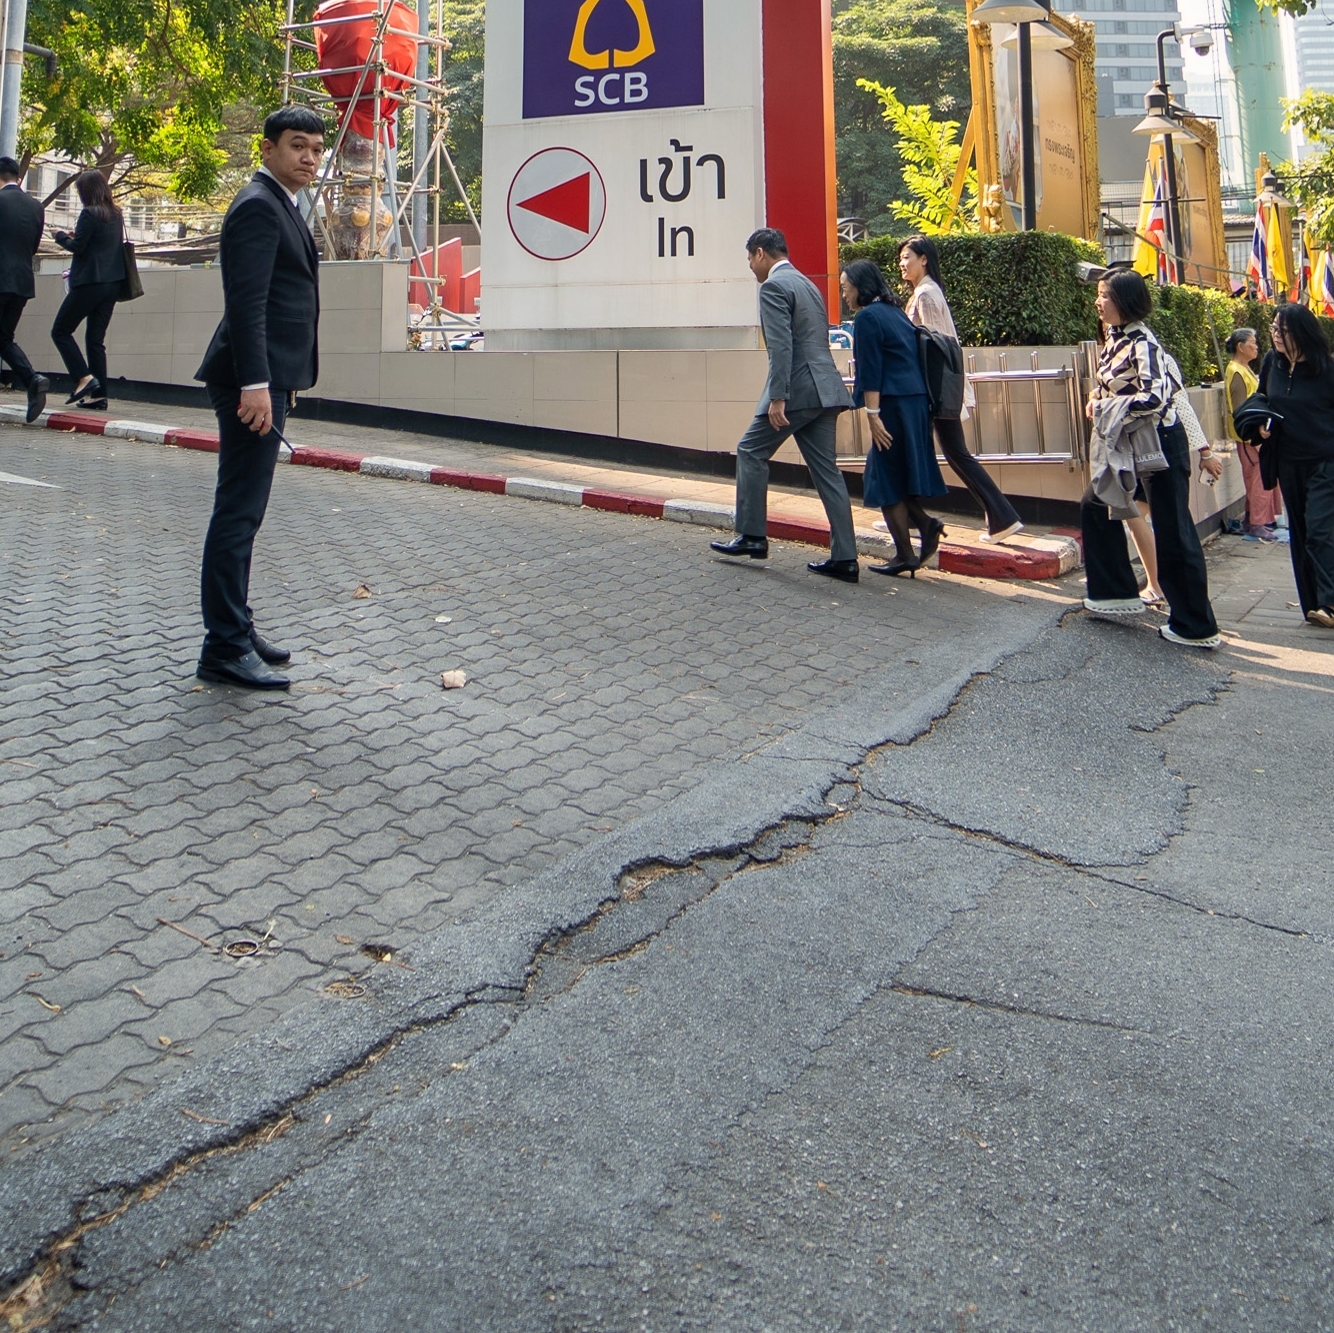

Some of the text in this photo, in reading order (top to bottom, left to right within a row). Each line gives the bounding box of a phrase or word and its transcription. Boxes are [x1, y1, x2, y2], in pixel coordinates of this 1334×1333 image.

[574, 71, 649, 107] SCB
[639, 138, 726, 203] เข้า
[657, 217, 695, 257] In
